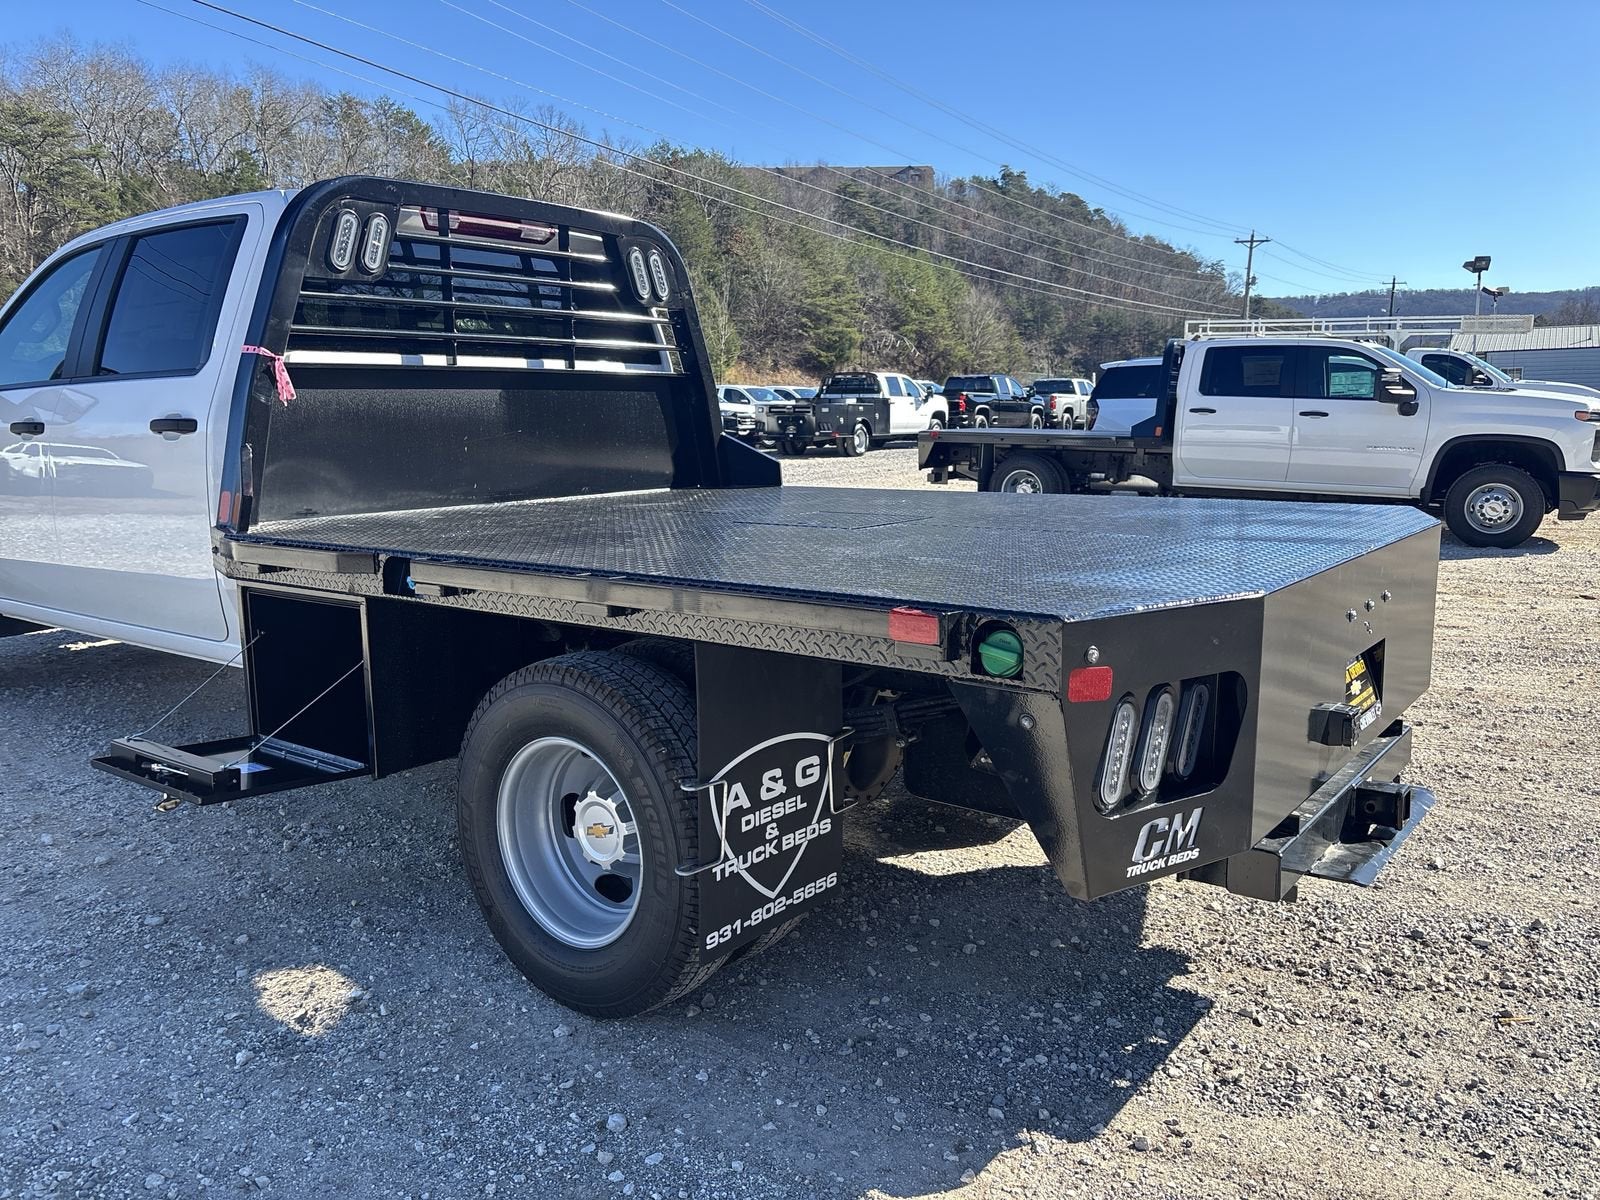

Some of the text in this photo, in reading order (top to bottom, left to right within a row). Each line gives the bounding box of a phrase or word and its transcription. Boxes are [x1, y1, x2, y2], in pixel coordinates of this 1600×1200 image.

[725, 755, 821, 816] A & G
[741, 794, 807, 832] DIESEL
[712, 818, 832, 882] TRUCK BEDS
[765, 822, 780, 840] &
[1131, 806, 1204, 864] CM
[1126, 847, 1200, 878] TRUCK BEDS
[705, 872, 838, 950] 931-802-5656
